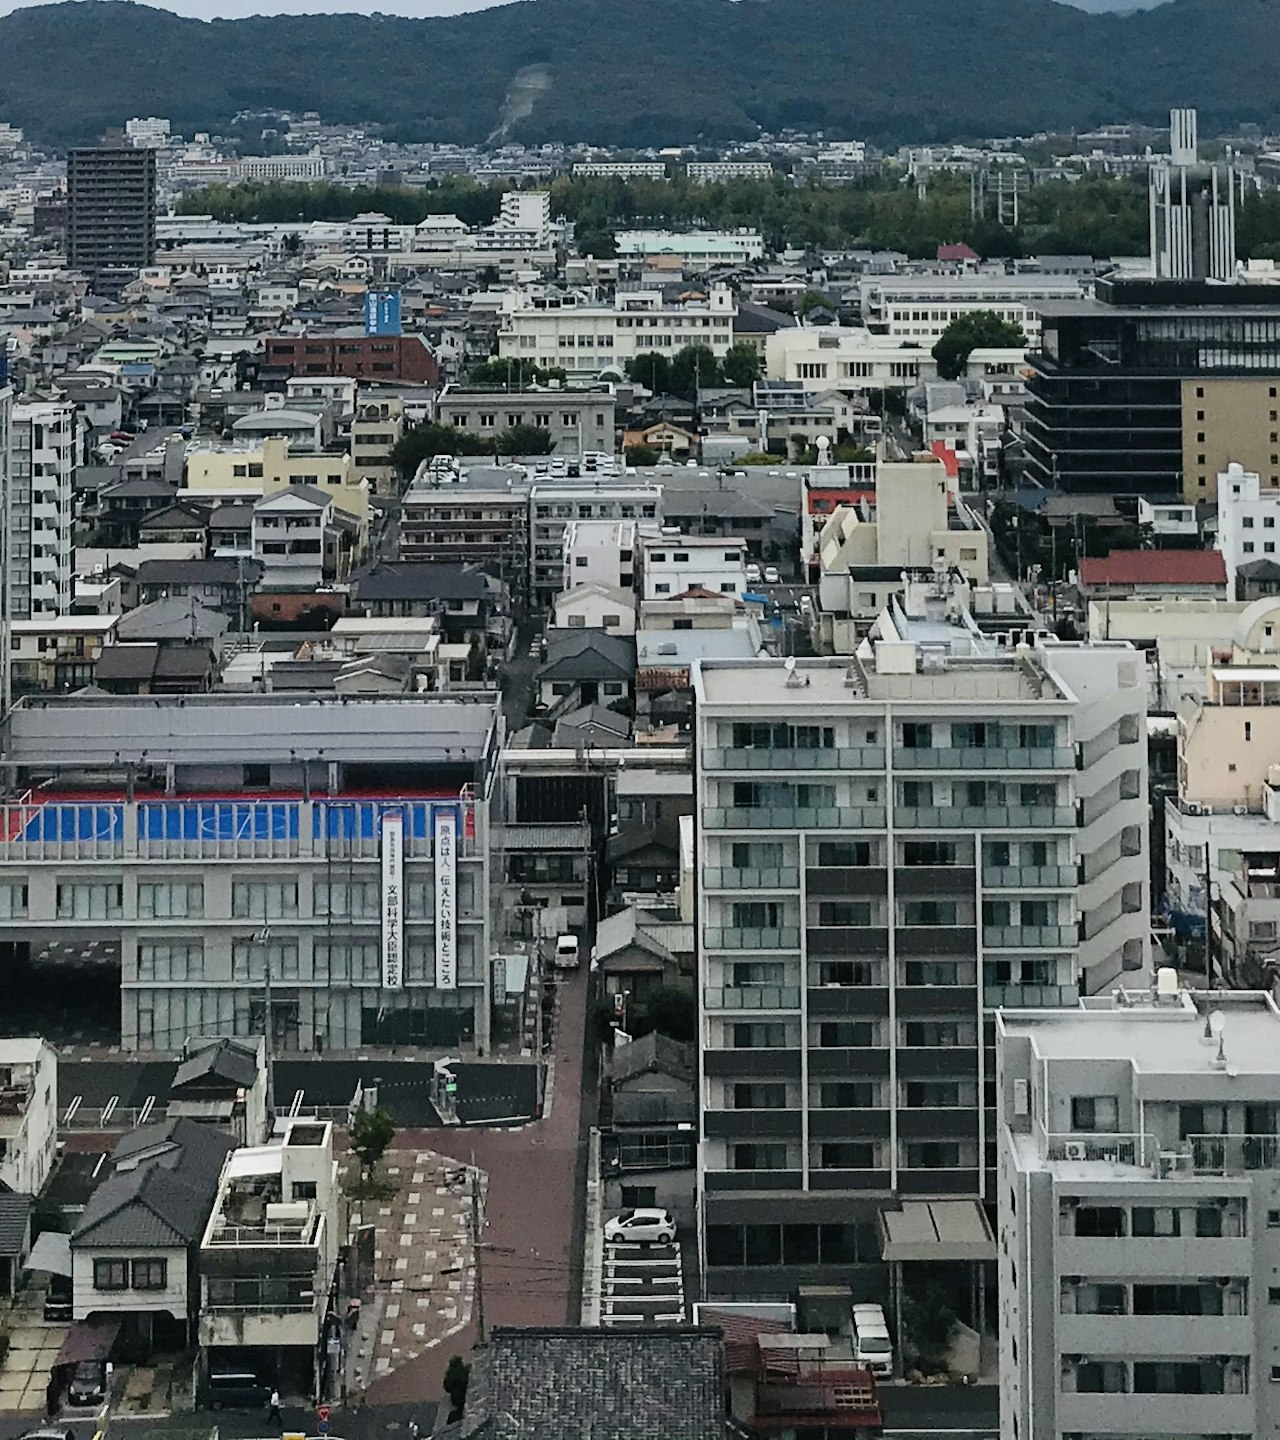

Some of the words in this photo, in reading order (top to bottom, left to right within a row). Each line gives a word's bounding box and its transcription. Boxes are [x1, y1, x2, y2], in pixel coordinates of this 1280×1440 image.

[387, 884, 398, 986] 文部科学大臣認定校
